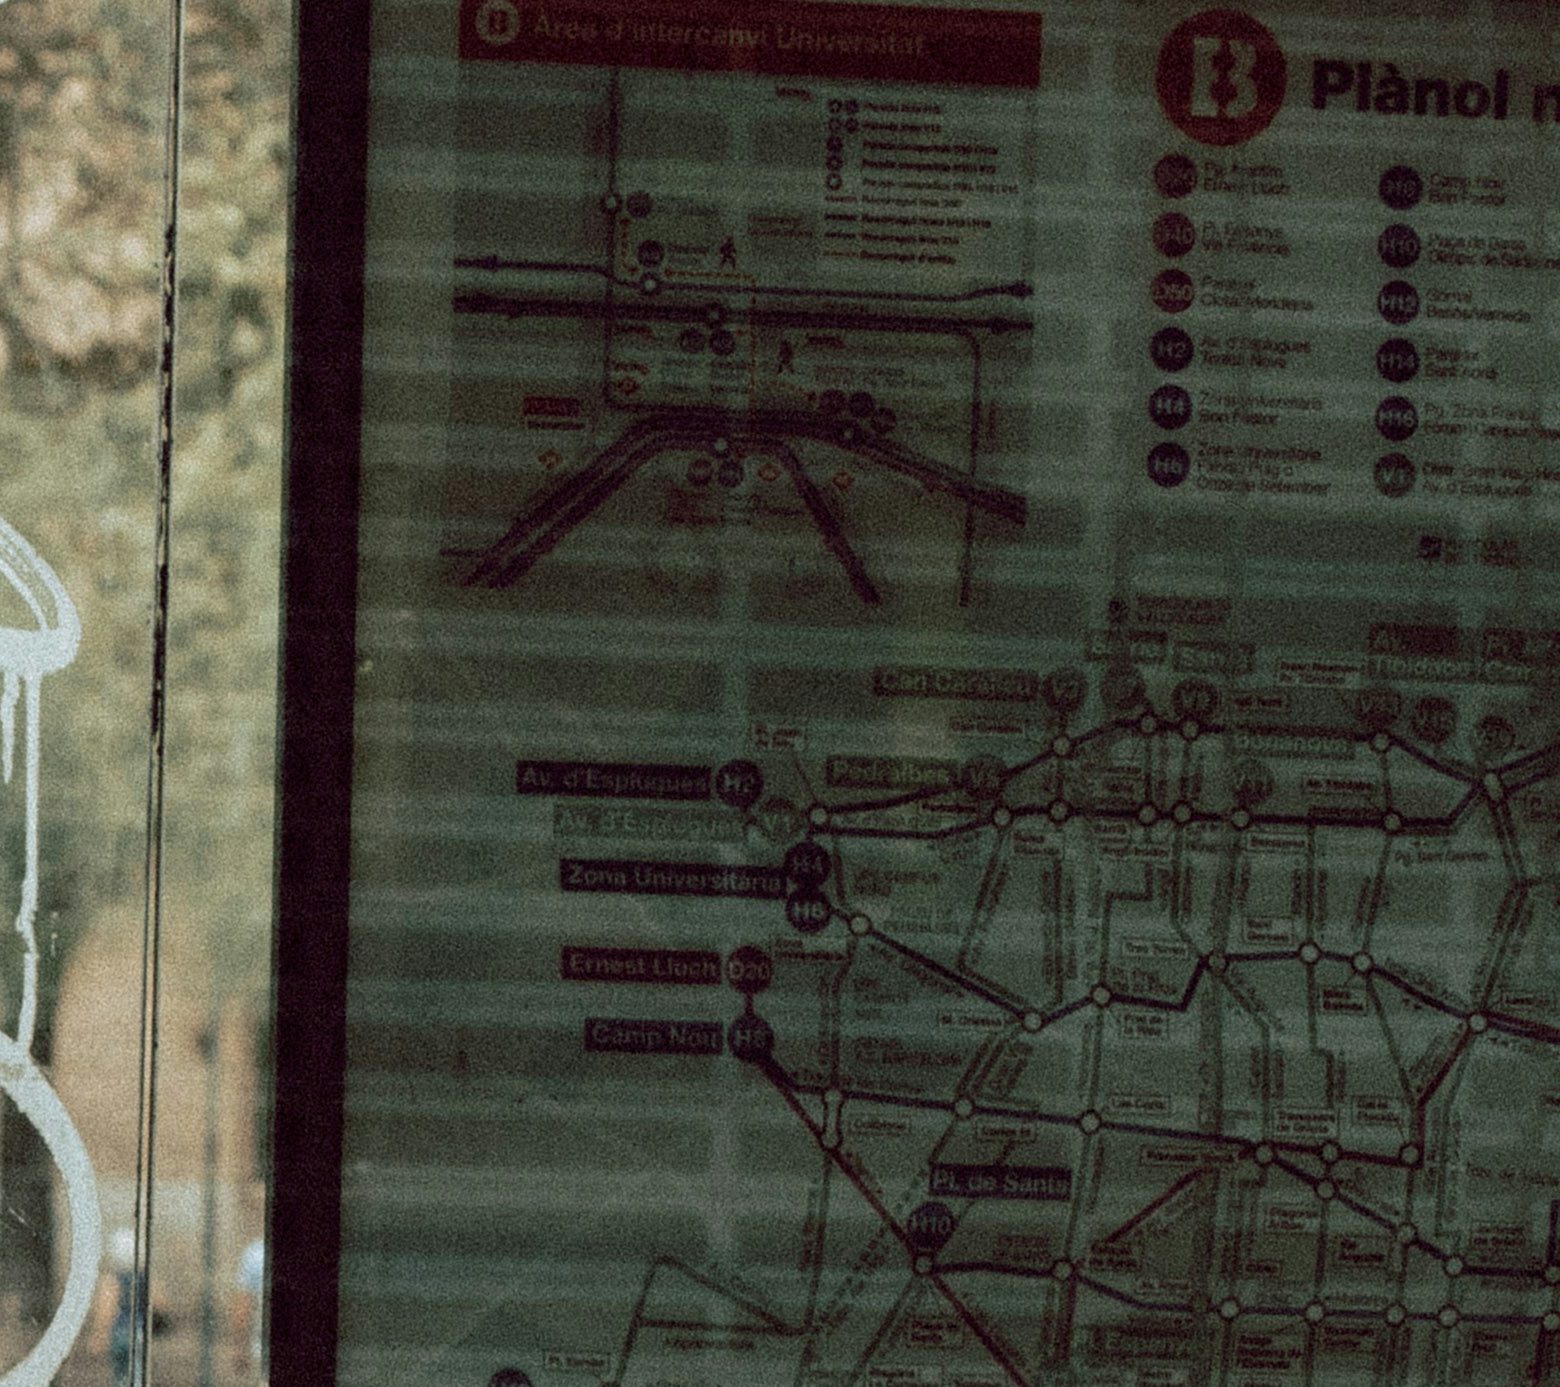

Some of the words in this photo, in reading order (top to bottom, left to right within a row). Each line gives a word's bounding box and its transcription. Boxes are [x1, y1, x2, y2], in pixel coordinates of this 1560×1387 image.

[1312, 59, 1510, 121] Plànol
[1378, 236, 1420, 256] H10
[1379, 294, 1417, 314] H12
[1156, 339, 1189, 360] H2
[1378, 351, 1417, 370] H14
[1155, 396, 1186, 416] H4
[1378, 410, 1416, 429] H16
[521, 766, 558, 788] Av.
[567, 768, 709, 794] d'Esplugues
[722, 772, 757, 792] H2
[560, 810, 596, 832] Av.
[601, 811, 747, 838] d'Esplugues
[567, 866, 628, 887] Zona
[634, 867, 783, 894] Universitària
[793, 855, 824, 877] H4
[791, 899, 825, 920] H6
[568, 957, 644, 978] Ernest
[651, 957, 718, 981] Lluch
[727, 960, 772, 980] D20
[590, 1025, 662, 1050] Camp
[668, 1027, 718, 1049] Nou
[734, 1028, 767, 1047] H8
[932, 1170, 958, 1192] Pl.
[968, 1173, 994, 1194] de
[1004, 1173, 1069, 1198] Sants
[910, 1216, 953, 1237] H10
